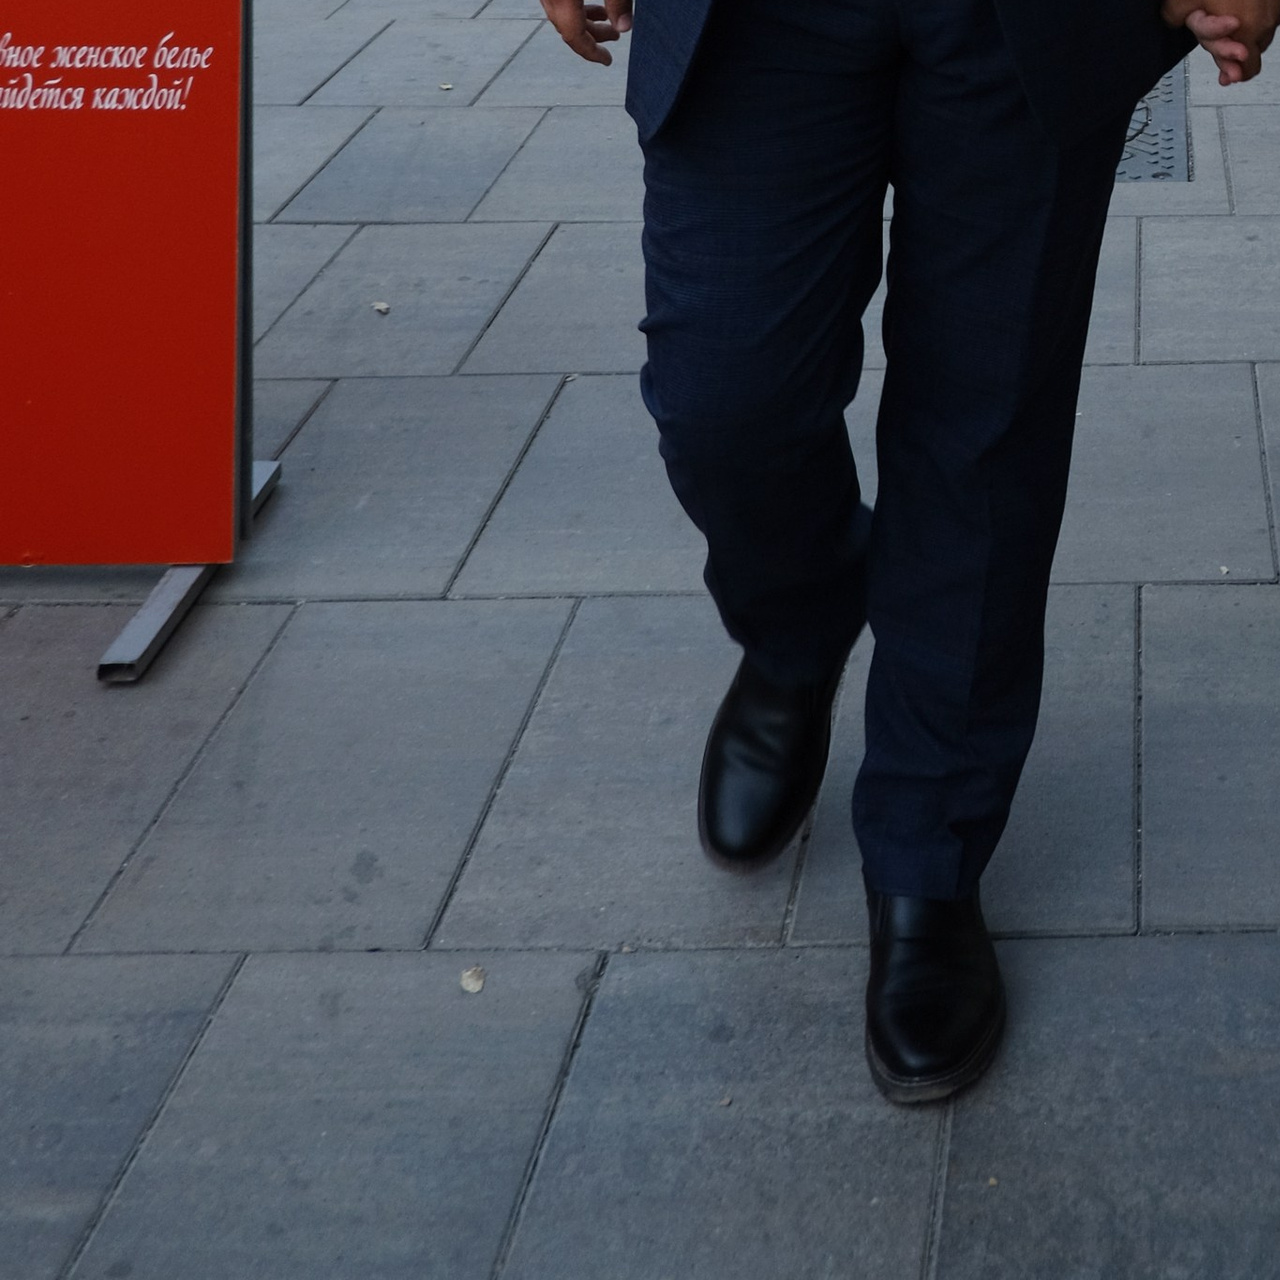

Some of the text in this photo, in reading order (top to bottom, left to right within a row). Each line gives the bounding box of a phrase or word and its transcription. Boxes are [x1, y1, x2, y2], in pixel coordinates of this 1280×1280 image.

[50, 45, 148, 69] женское
[153, 31, 214, 69] белье
[91, 73, 194, 111] каждой!
